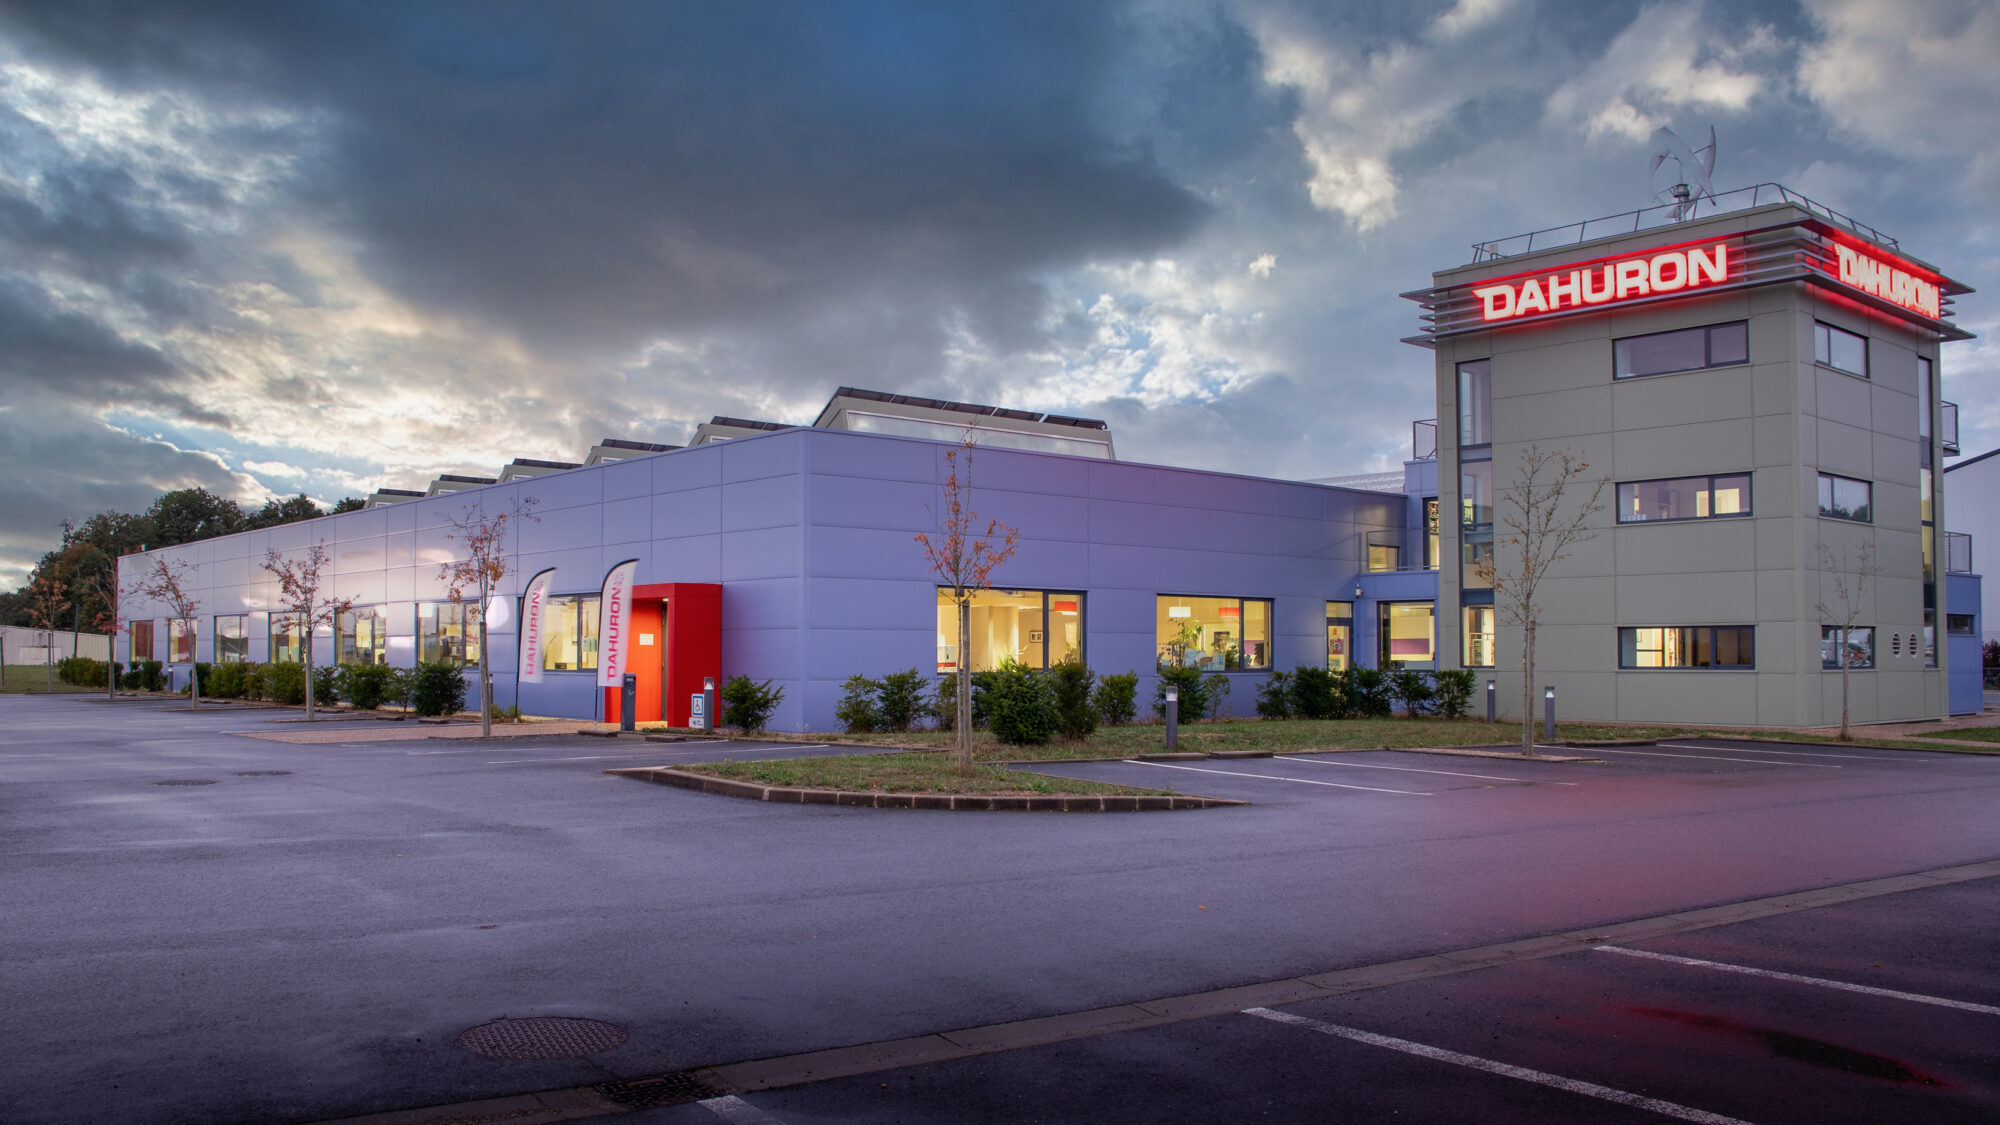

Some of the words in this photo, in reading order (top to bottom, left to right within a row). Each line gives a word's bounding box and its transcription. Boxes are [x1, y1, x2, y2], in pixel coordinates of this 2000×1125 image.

[1473, 243, 1728, 321] DAHURON
[1833, 243, 1940, 320] DAHURON
[525, 592, 541, 676] DAHURON
[606, 587, 622, 681] DAHURON
